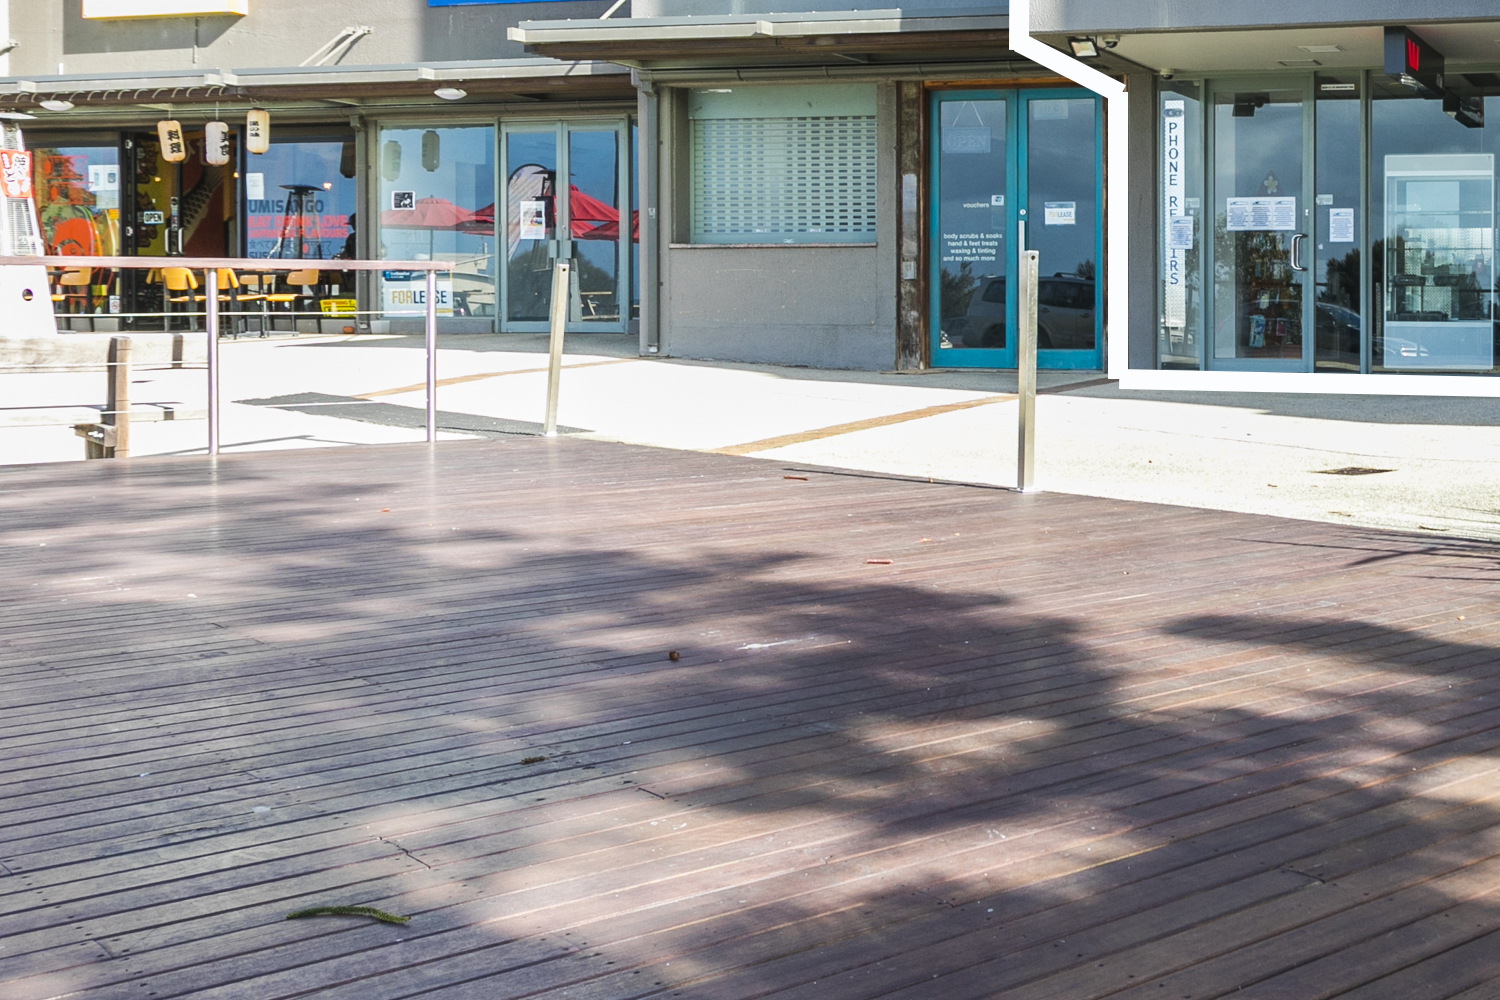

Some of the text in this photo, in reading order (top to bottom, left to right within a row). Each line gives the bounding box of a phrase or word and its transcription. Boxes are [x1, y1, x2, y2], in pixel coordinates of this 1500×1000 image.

[1168, 122, 1179, 186] PHONE
[145, 212, 162, 222] OPEN
[247, 215, 272, 228] EAT
[316, 214, 349, 228] LOVE
[1169, 196, 1179, 285] REIRS
[413, 290, 447, 304] LESE
